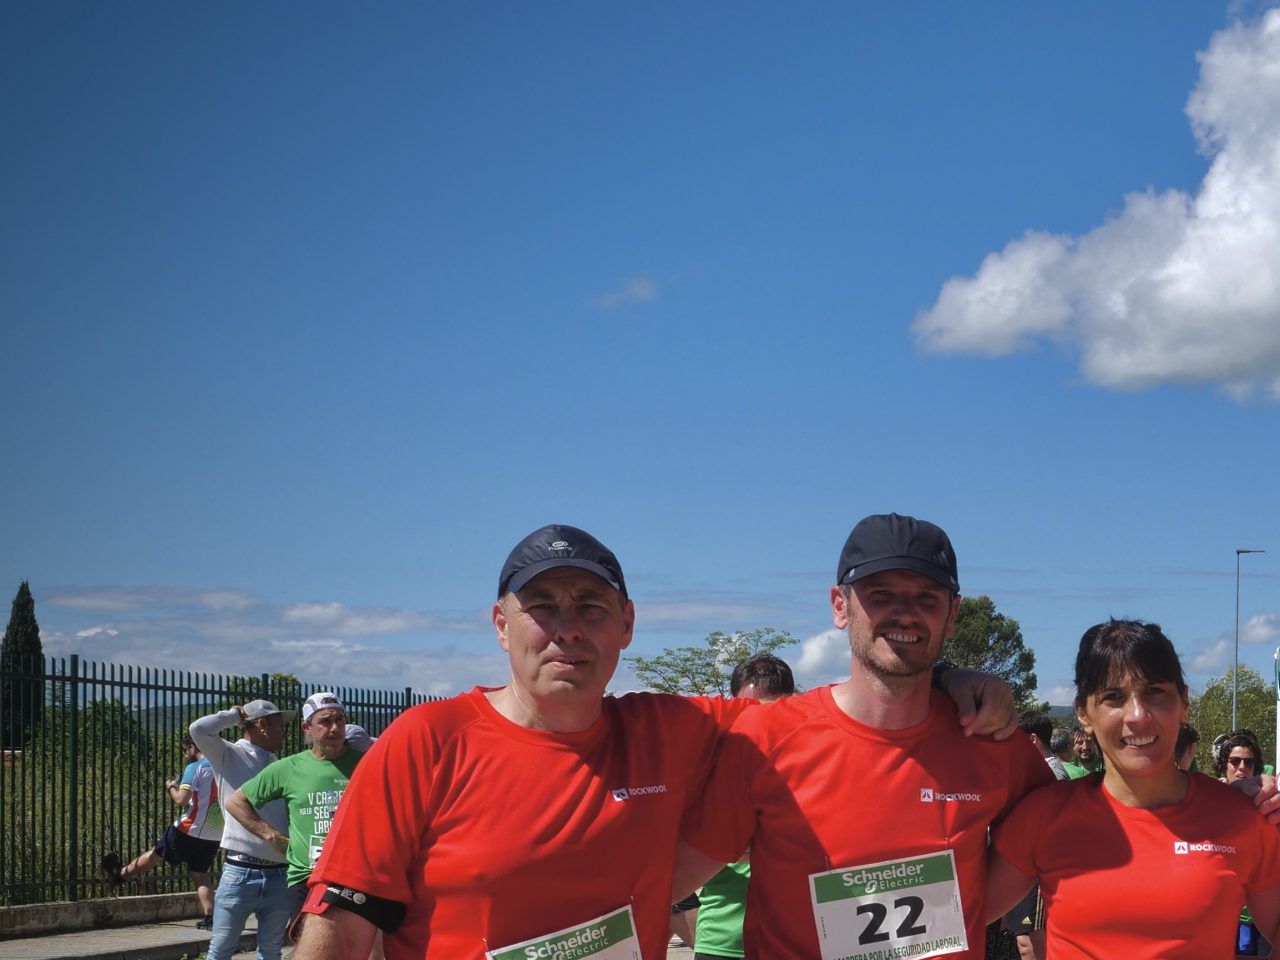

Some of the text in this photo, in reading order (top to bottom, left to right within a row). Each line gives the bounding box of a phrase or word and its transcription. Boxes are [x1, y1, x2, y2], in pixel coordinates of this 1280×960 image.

[307, 791, 314, 806] V
[934, 792, 981, 801] ROCKWOOL
[1189, 843, 1236, 854] ROCKWOOL
[842, 863, 924, 887] Schneider
[880, 875, 924, 890] Electric
[856, 896, 927, 946] 22
[566, 937, 609, 960] Electric
[884, 948, 894, 960] LA
[894, 941, 930, 960] SEGURIDAD
[931, 935, 962, 951] LABORAL
